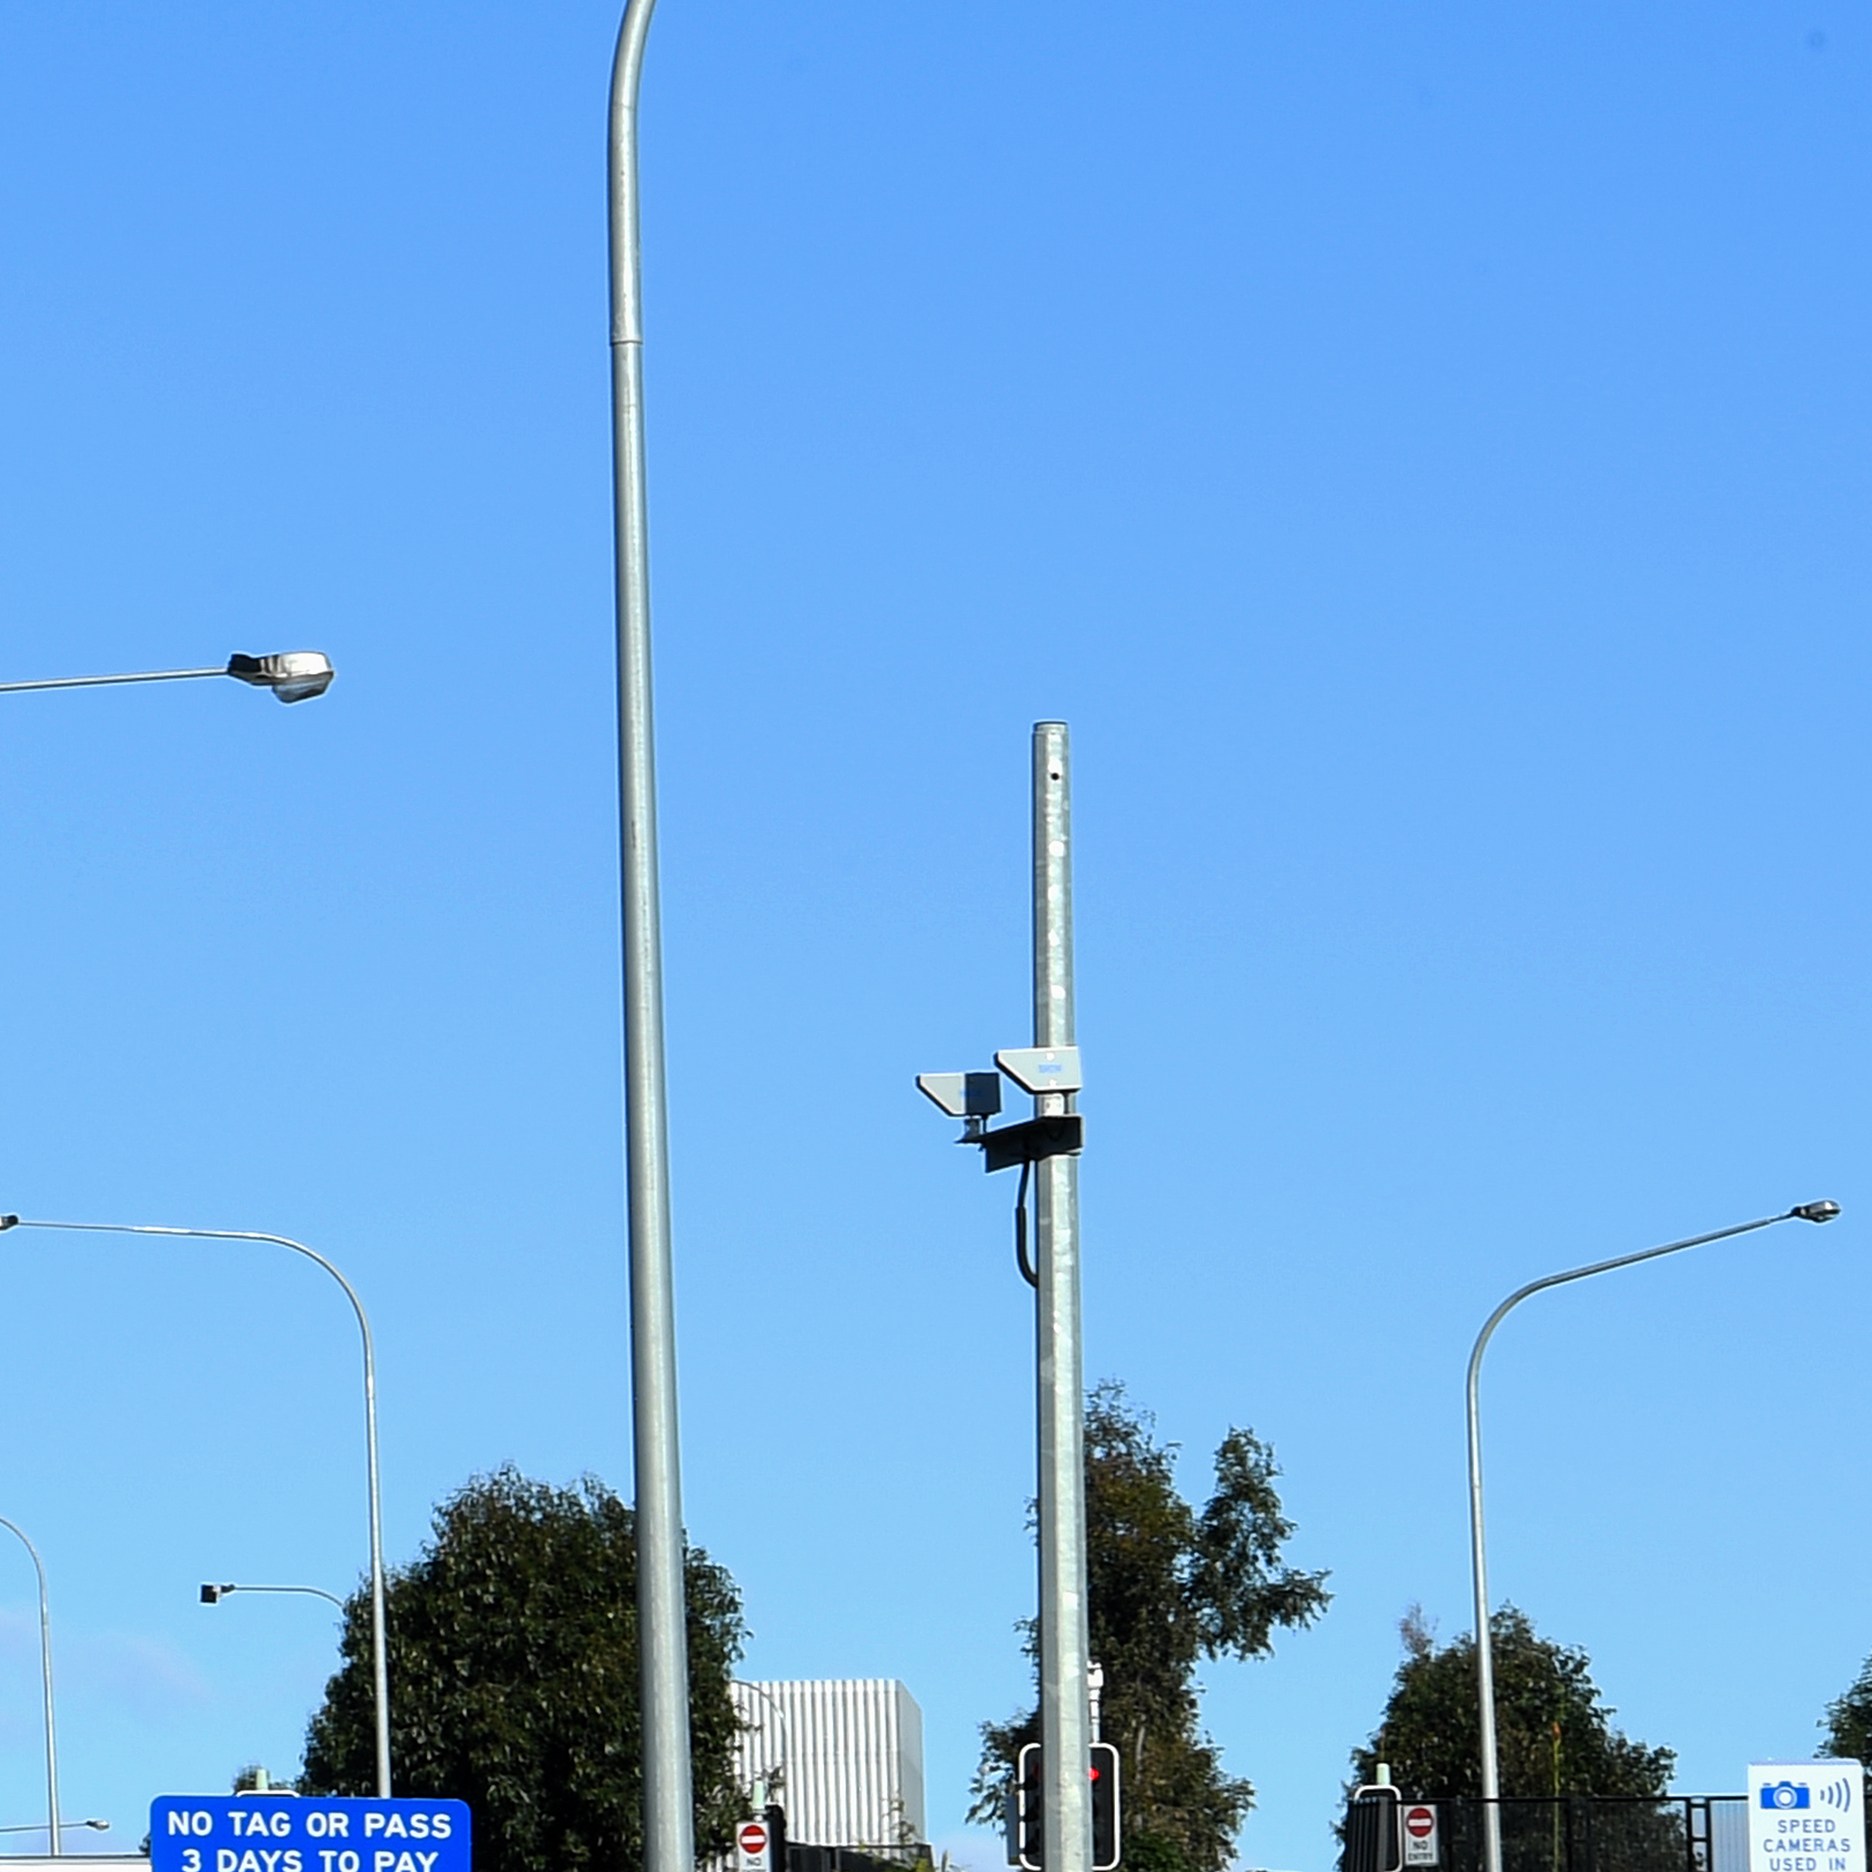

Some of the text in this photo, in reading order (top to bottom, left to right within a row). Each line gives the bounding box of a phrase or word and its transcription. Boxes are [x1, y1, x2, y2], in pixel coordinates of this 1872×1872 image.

[167, 1811, 452, 1839] NO TAG OR PASS
[1778, 1819, 1836, 1833] SPEED
[1763, 1838, 1851, 1852] CAMERAS
[1769, 1857, 1846, 1871] USED IN
